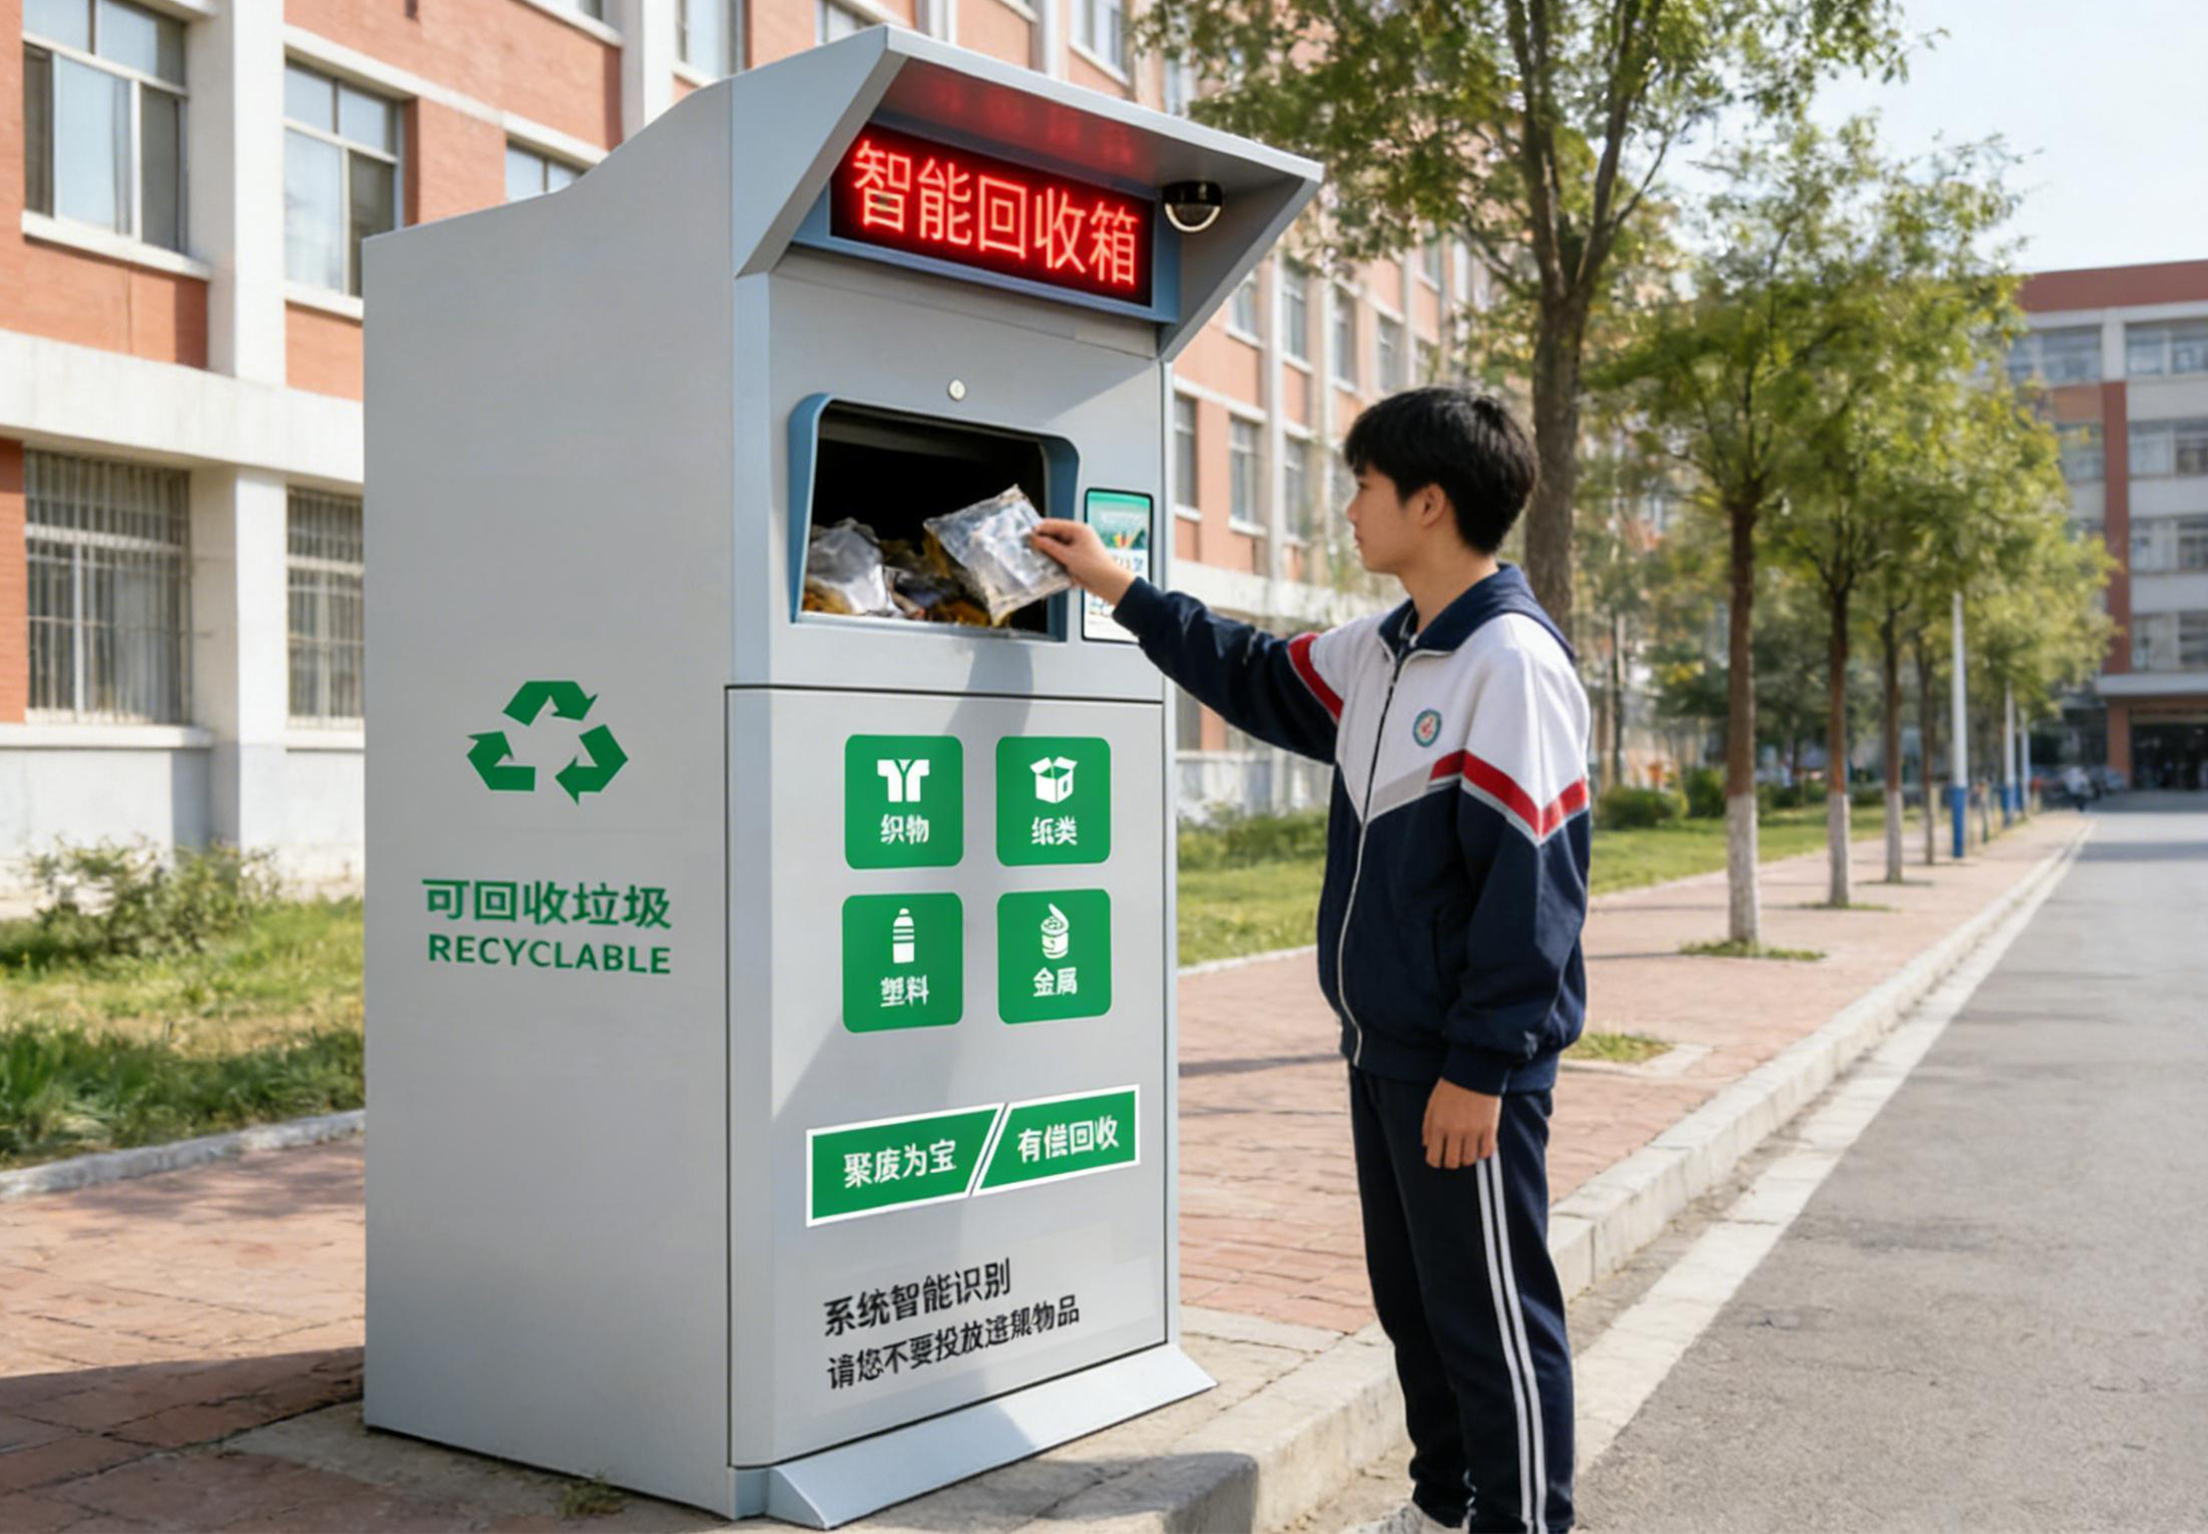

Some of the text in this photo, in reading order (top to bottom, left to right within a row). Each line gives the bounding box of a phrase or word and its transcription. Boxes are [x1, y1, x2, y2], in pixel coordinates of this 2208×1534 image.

[853, 140, 1139, 286] 智能回收箱
[880, 814, 929, 845] 织物
[1031, 816, 1077, 846] 纸类
[422, 879, 671, 929] 可回收垃圾
[429, 934, 671, 974] RECYCLABLE
[880, 975, 929, 1007] 塑料
[1033, 967, 1077, 997] 金属
[1017, 1114, 1119, 1163] 有偿回收
[844, 1139, 957, 1188] 聚废为宝
[824, 1257, 1011, 1337] 系统智能识别
